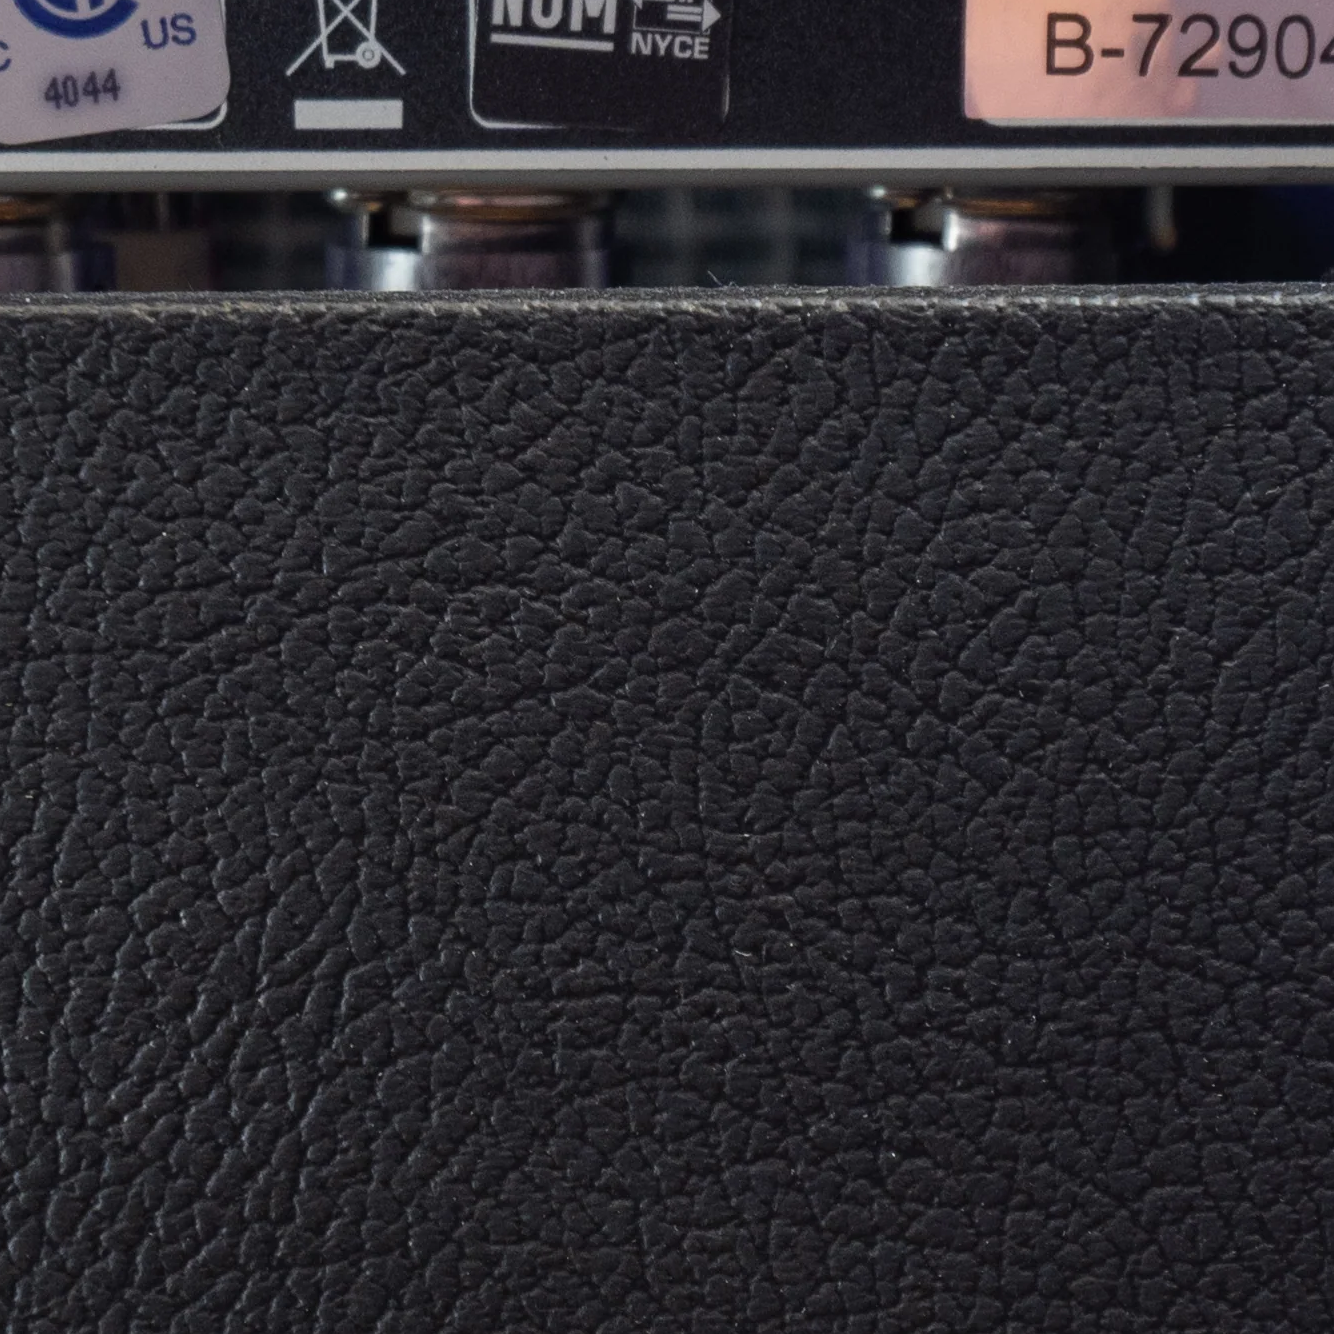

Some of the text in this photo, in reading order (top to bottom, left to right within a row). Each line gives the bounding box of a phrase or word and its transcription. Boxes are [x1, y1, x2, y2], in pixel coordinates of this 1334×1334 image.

[140, 12, 197, 50] US
[630, 31, 710, 60] NYCE
[43, 67, 122, 110] 4044
